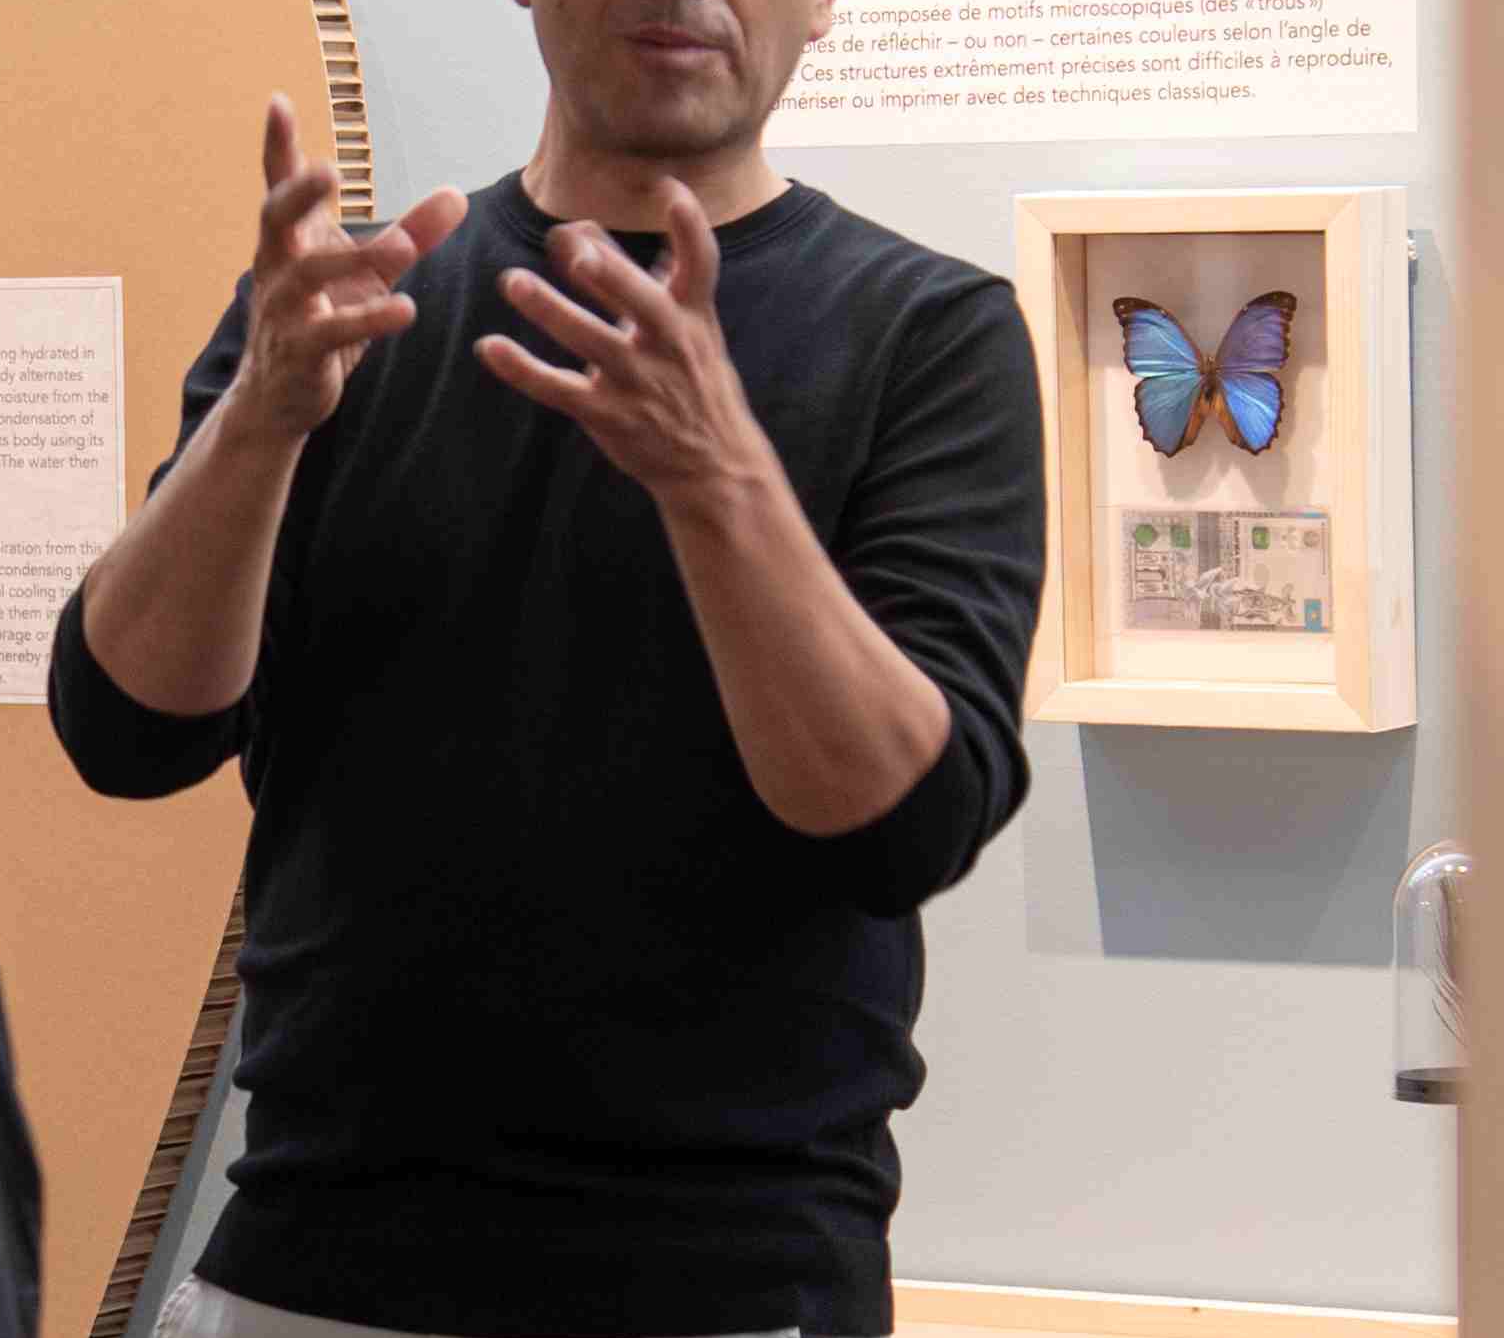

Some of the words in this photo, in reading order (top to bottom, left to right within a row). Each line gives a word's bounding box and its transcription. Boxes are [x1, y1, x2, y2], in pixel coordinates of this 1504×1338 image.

[859, 3, 953, 28] composée
[870, 31, 943, 53] réfléchir
[992, 33, 1028, 49] non
[1049, 26, 1134, 48] certaines
[1137, 22, 1217, 45] couleurs
[1222, 20, 1273, 42] selon
[800, 62, 835, 83] Ces
[838, 62, 929, 83] structures
[932, 57, 1056, 79] extrêmement
[1060, 54, 1137, 80] précises
[1187, 49, 1265, 72] difficiles
[880, 87, 961, 113] imprimer
[965, 90, 1009, 107] avec
[1012, 84, 1047, 105] des
[1051, 83, 1153, 107] techniques
